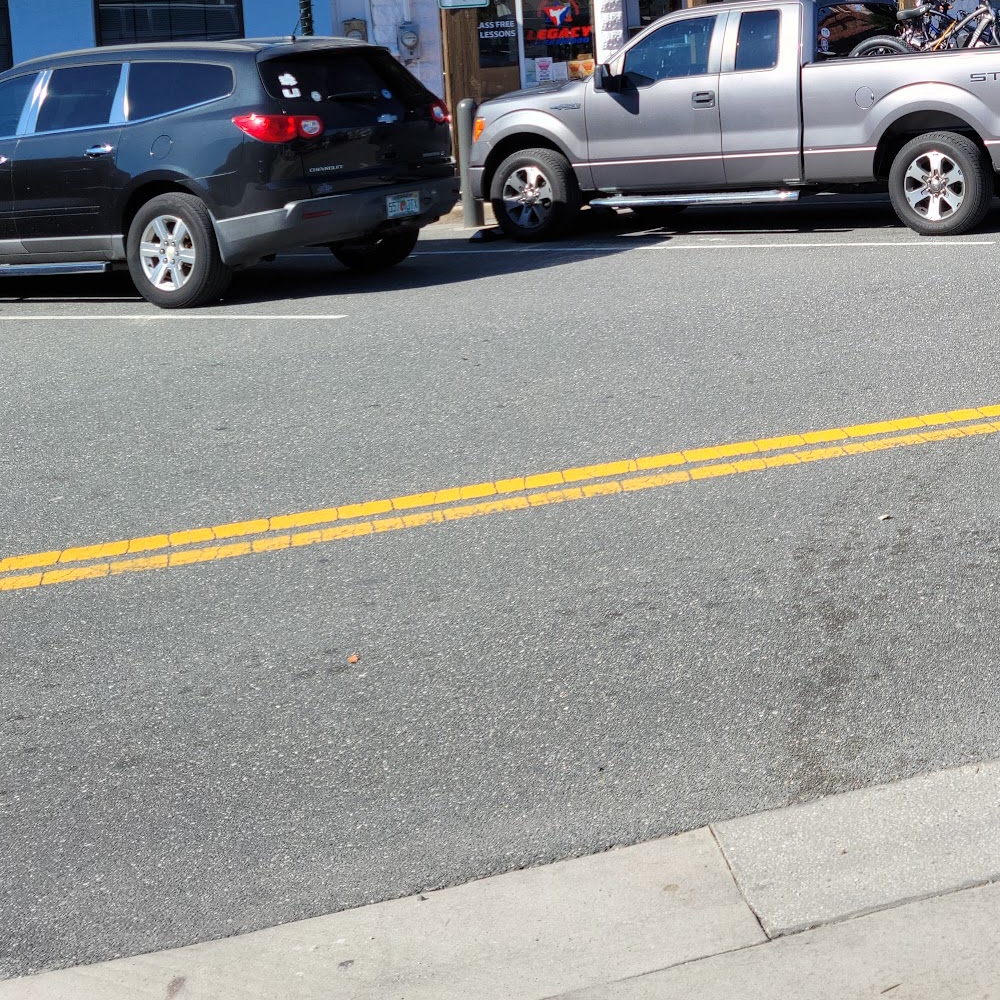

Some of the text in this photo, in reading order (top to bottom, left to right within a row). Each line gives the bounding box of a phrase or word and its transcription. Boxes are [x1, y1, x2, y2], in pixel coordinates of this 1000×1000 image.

[496, 20, 515, 29] FREE
[480, 30, 516, 39] LESSONS
[527, 25, 592, 40] LEGACY
[309, 164, 344, 172] CHEVROLET
